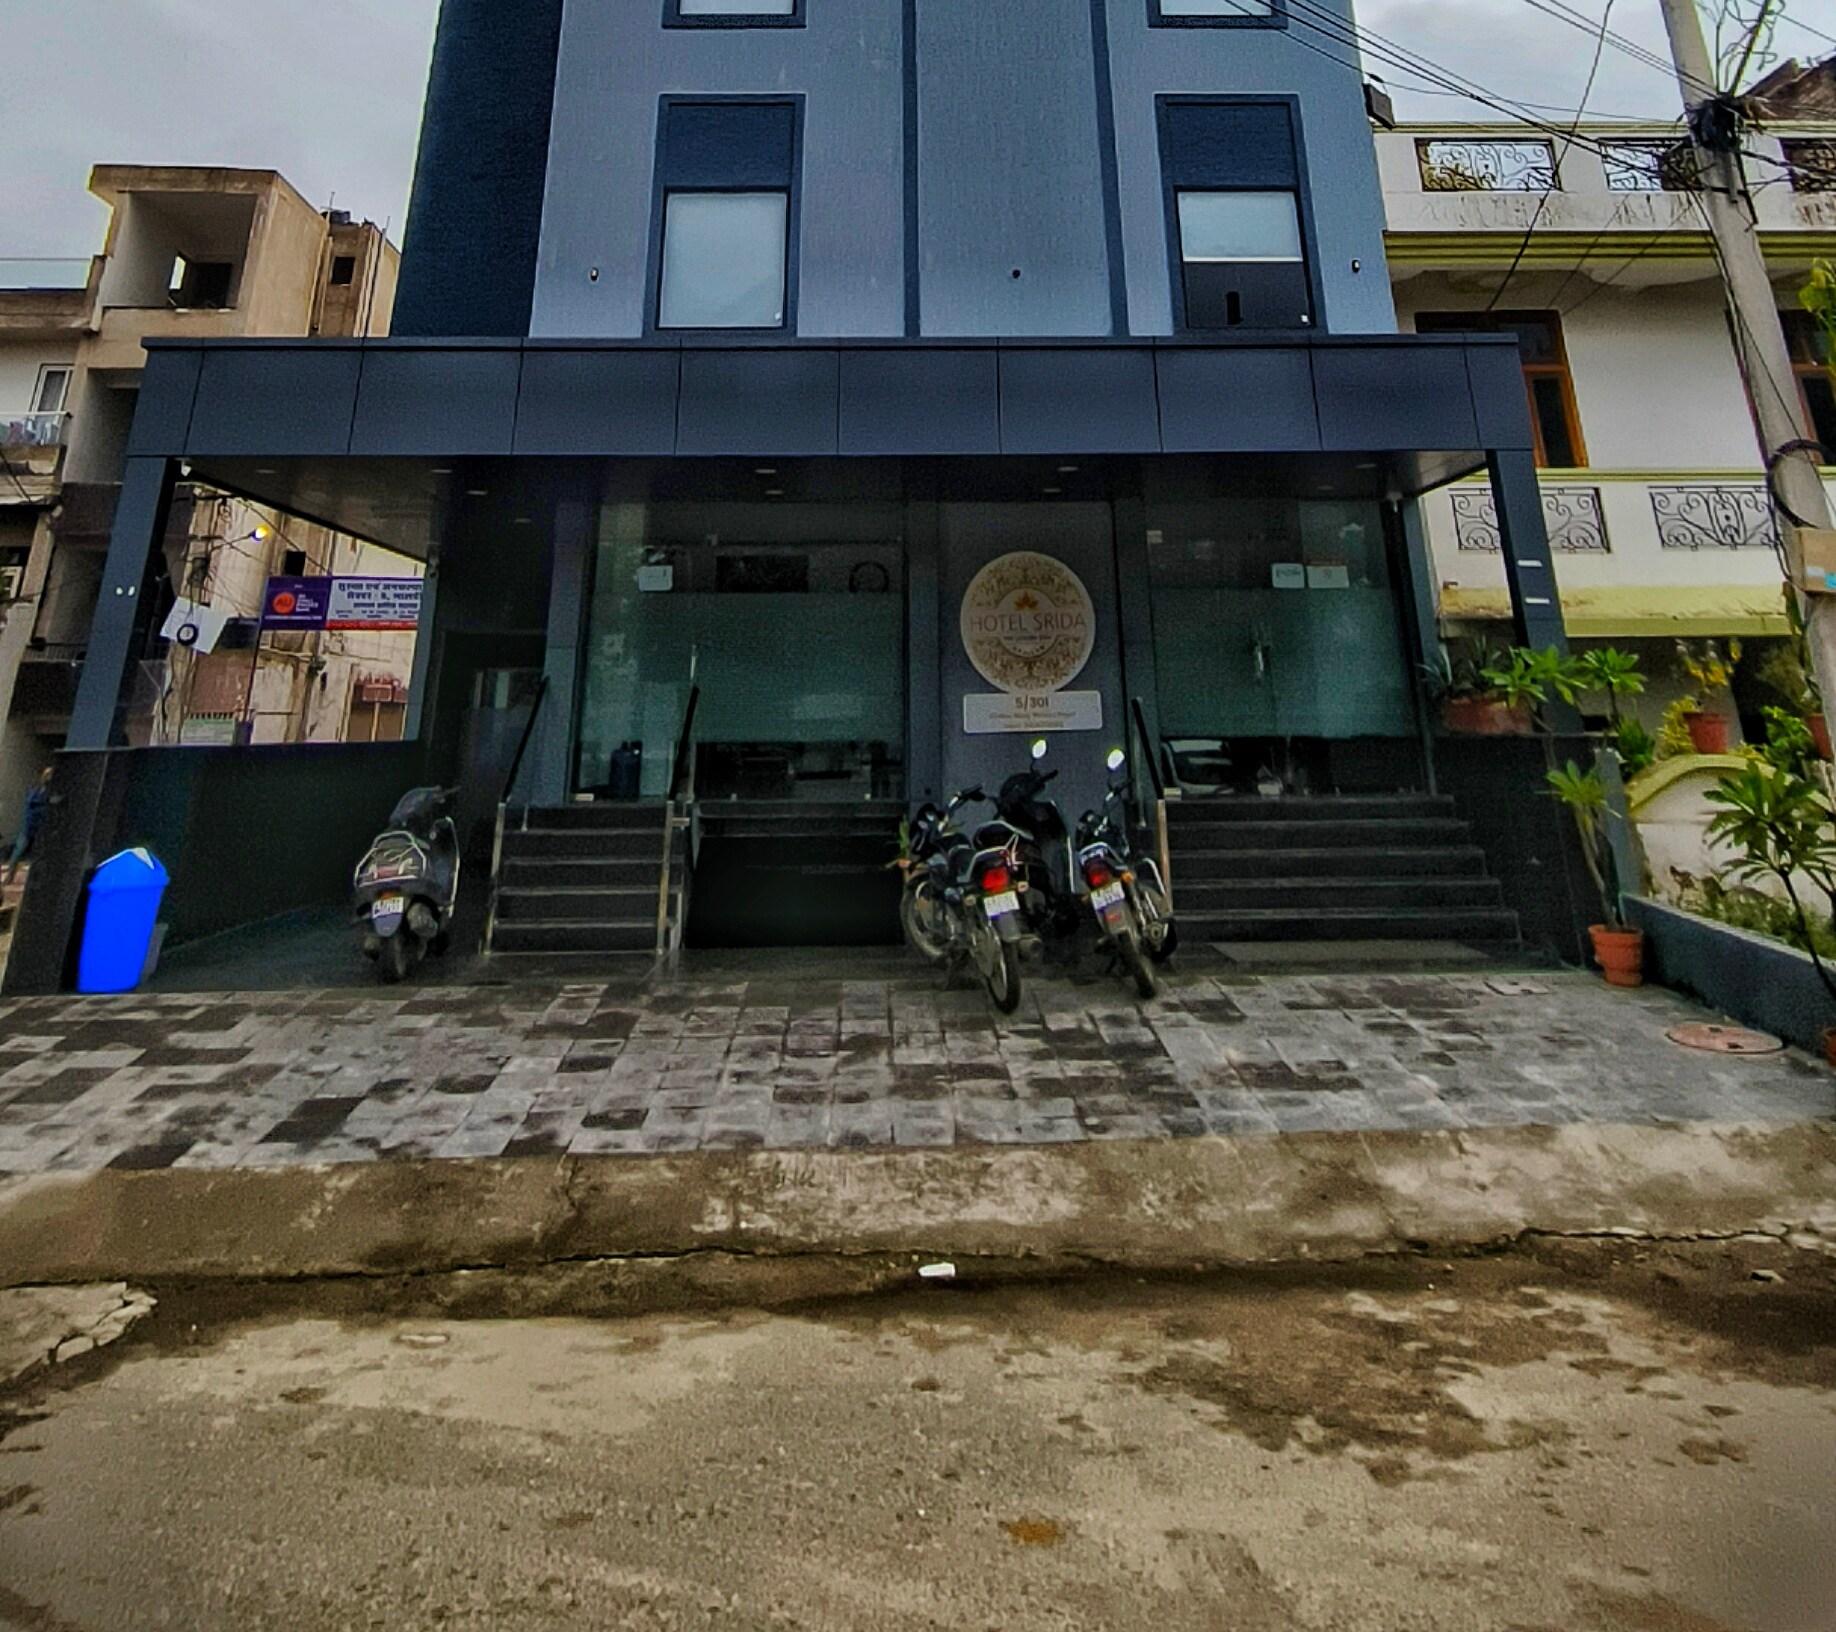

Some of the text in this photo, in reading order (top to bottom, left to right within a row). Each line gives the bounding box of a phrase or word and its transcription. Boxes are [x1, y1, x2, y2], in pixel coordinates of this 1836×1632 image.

[970, 612, 1086, 632] HOTEL SRIDA
[1015, 695, 1049, 710] 5/301
